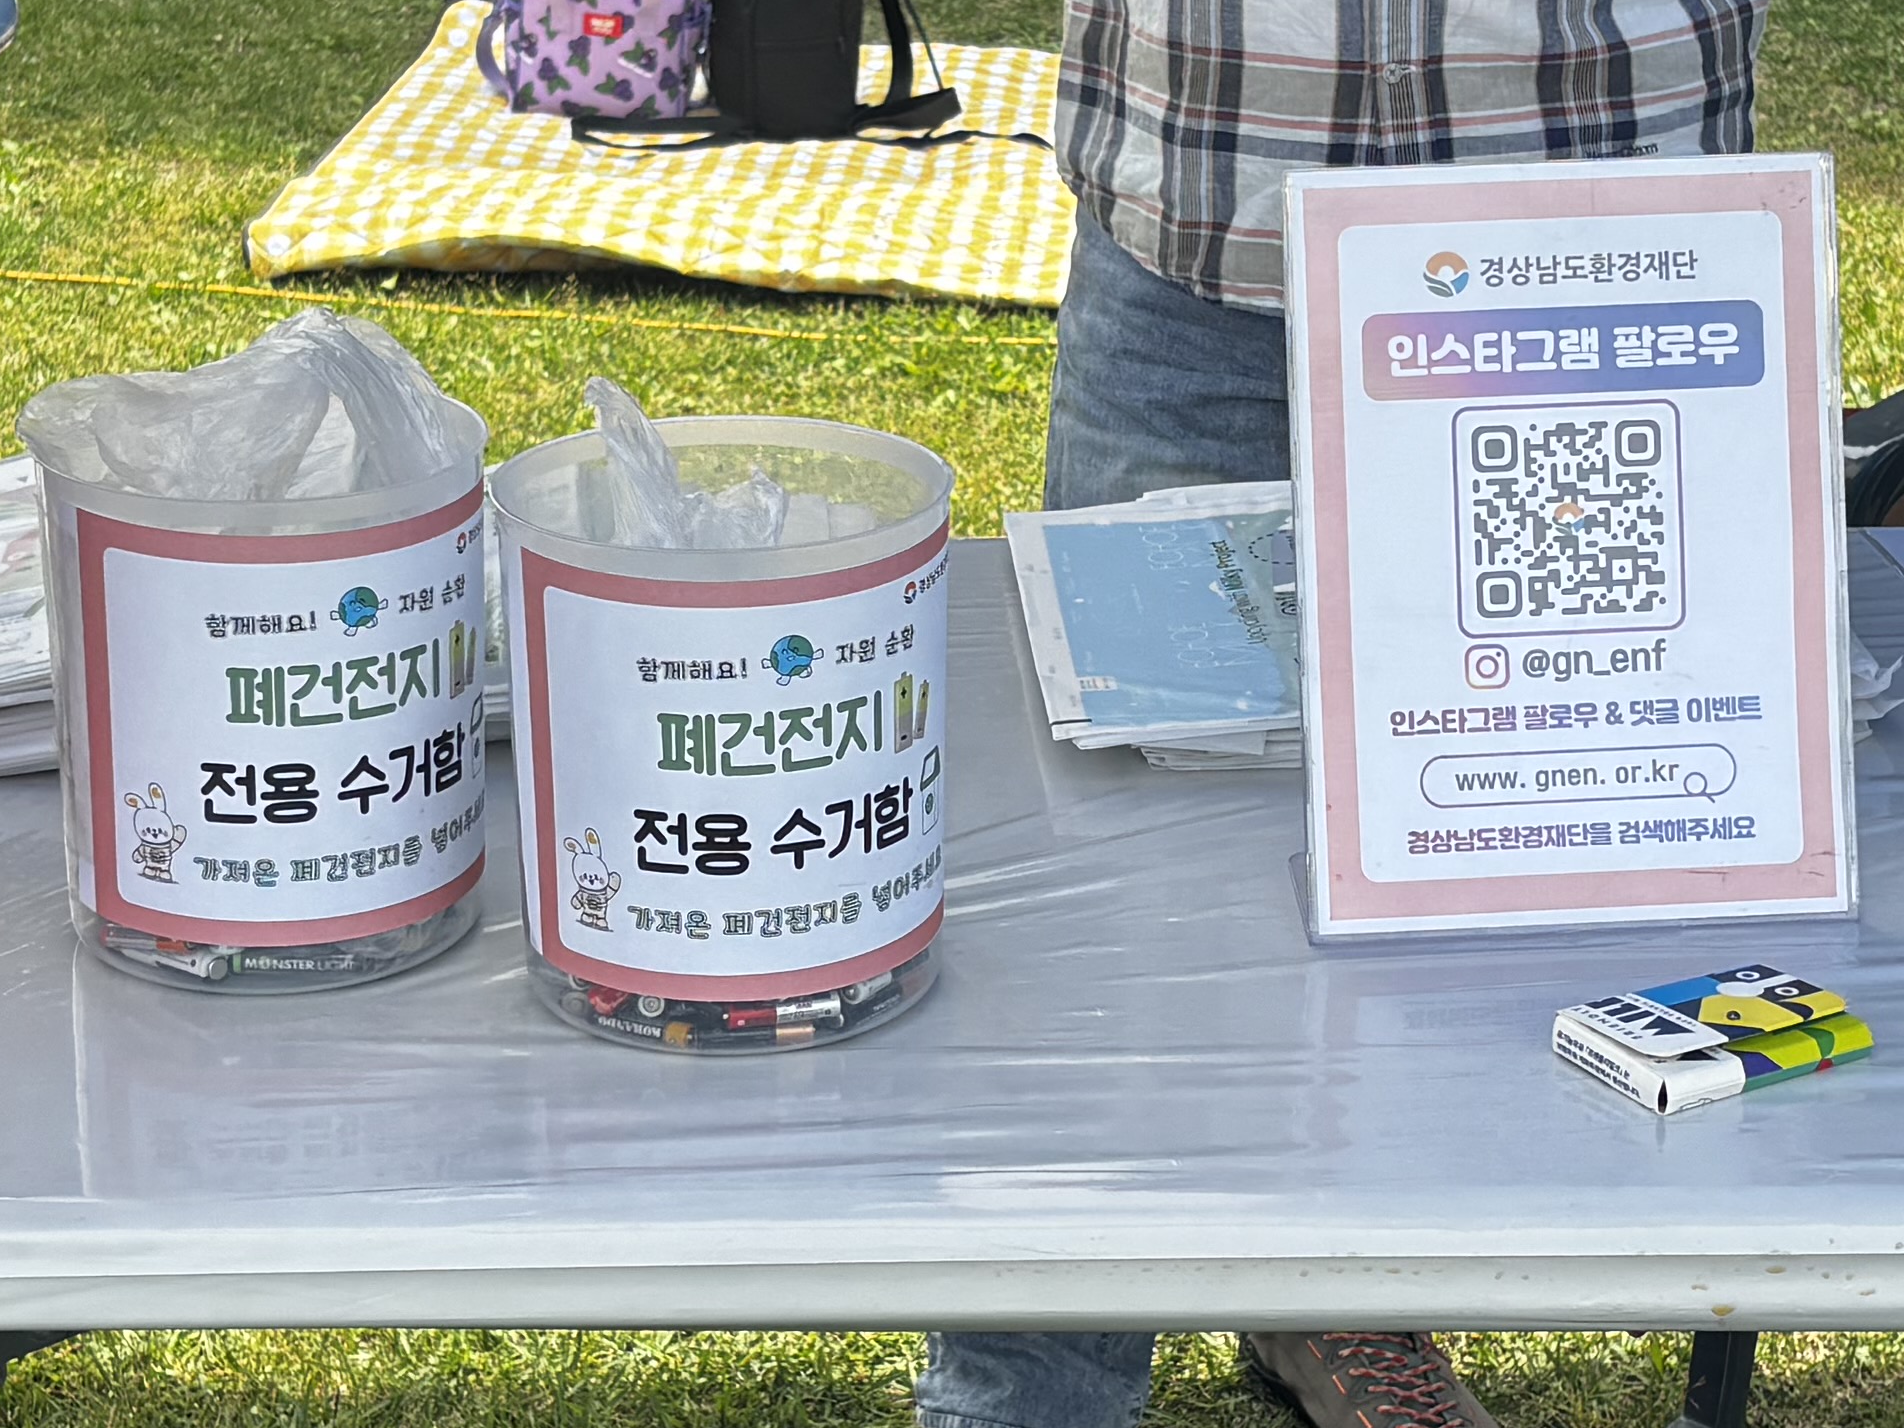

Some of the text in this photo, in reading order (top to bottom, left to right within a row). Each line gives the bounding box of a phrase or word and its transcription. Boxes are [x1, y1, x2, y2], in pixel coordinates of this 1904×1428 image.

[1480, 249, 1698, 288] 경상남도환경재단
[1387, 322, 1741, 378] 인스타그램 팔로우
[204, 609, 318, 640] 함께해요!
[398, 585, 435, 614] 자원
[225, 637, 441, 728] 폐건전지
[635, 656, 749, 684] 함께해요!
[835, 635, 877, 666] 자원
[1521, 638, 1667, 683] @gn_enf
[657, 689, 883, 778] 폐건전지
[1389, 695, 1763, 738] 인스타그램 팔로우 & 댓글 이벤트
[200, 721, 466, 824] 전용 수거함
[1454, 769, 1527, 792] www.
[1615, 758, 1680, 786] or.kr
[194, 788, 486, 888] 가져온 폐건전지를 넣어주세
[633, 776, 914, 876] 전용 수거함
[1407, 815, 1757, 855] 경상남도환경재단을 검색해주세요
[627, 903, 713, 940] 가져온
[722, 891, 863, 938] 폐건전지를
[244, 955, 316, 972] MONSTER
